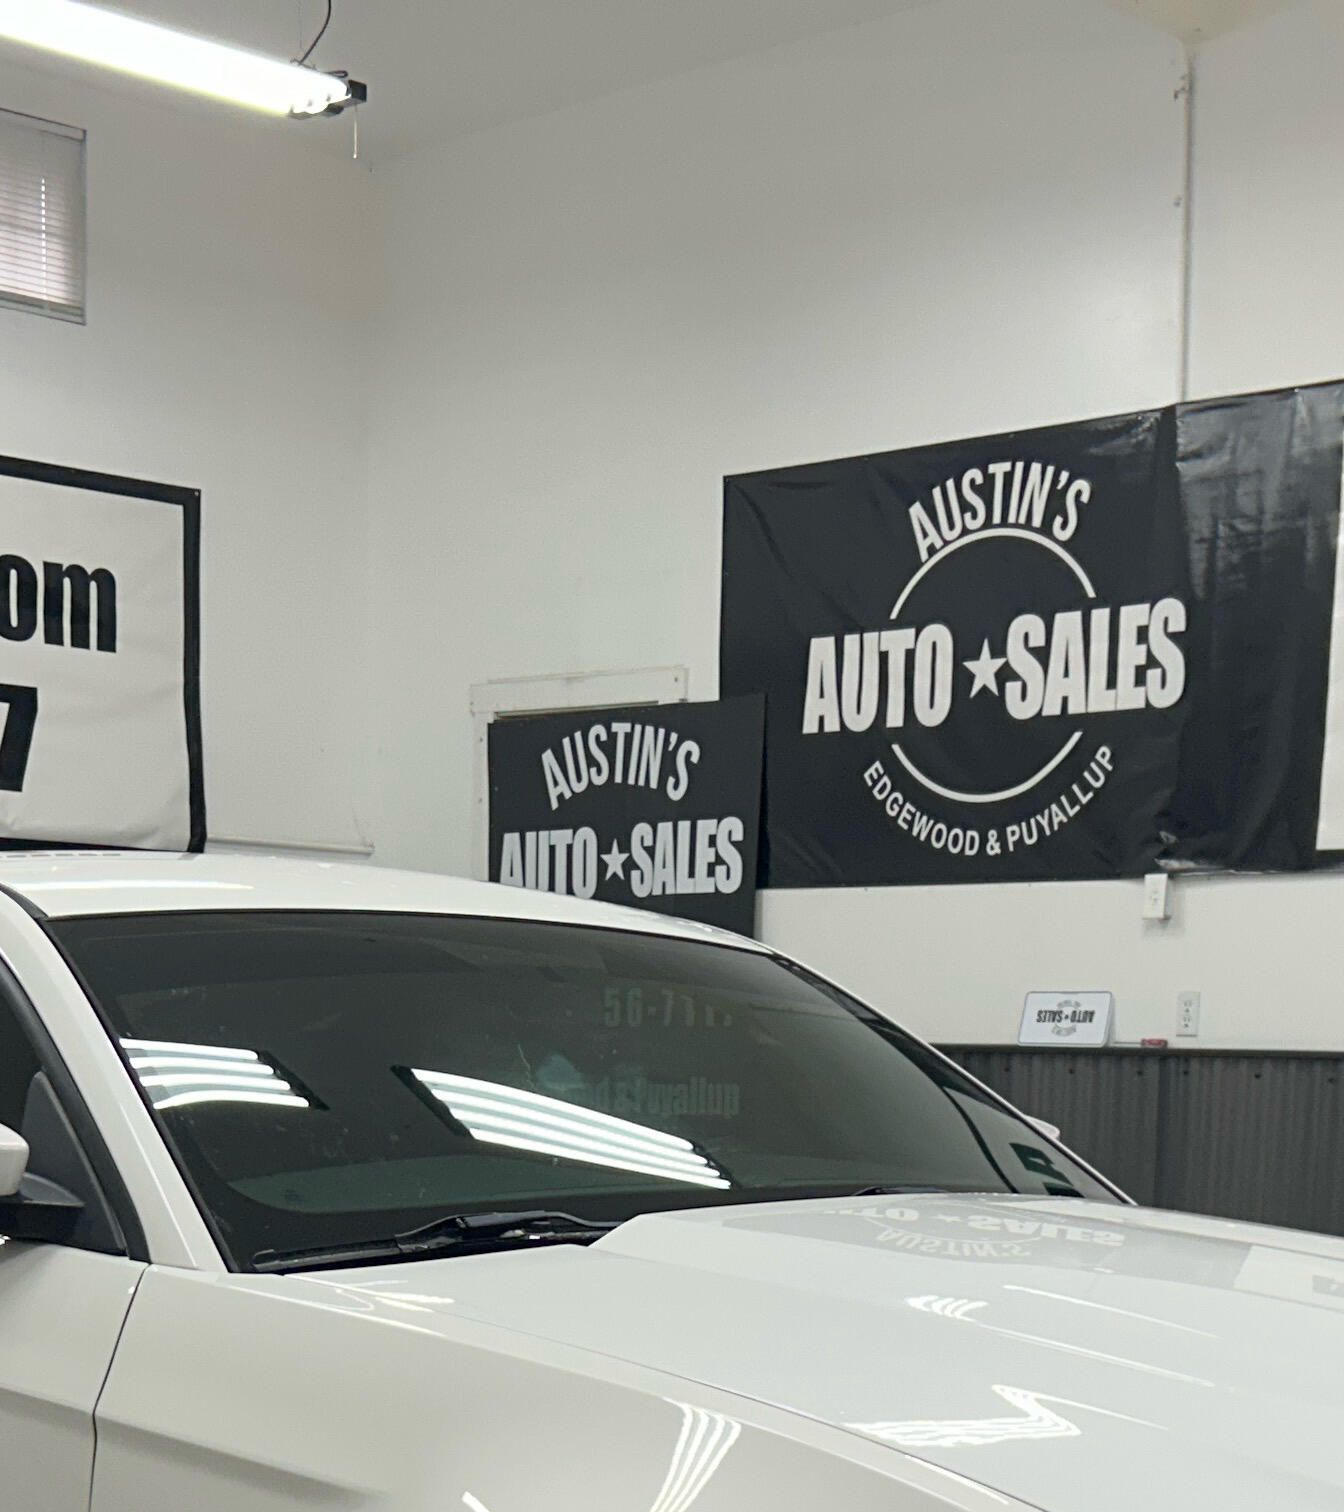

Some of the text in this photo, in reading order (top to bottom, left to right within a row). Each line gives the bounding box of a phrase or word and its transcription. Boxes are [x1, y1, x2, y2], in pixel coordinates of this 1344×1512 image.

[908, 461, 1091, 563] AUSTIN'S
[802, 597, 1186, 734] AUTO SALES
[541, 722, 701, 811] AUSTIN'S
[863, 745, 1114, 856] EDGEWOOD & PUYALLUP
[500, 816, 744, 899] AUTO SALES
